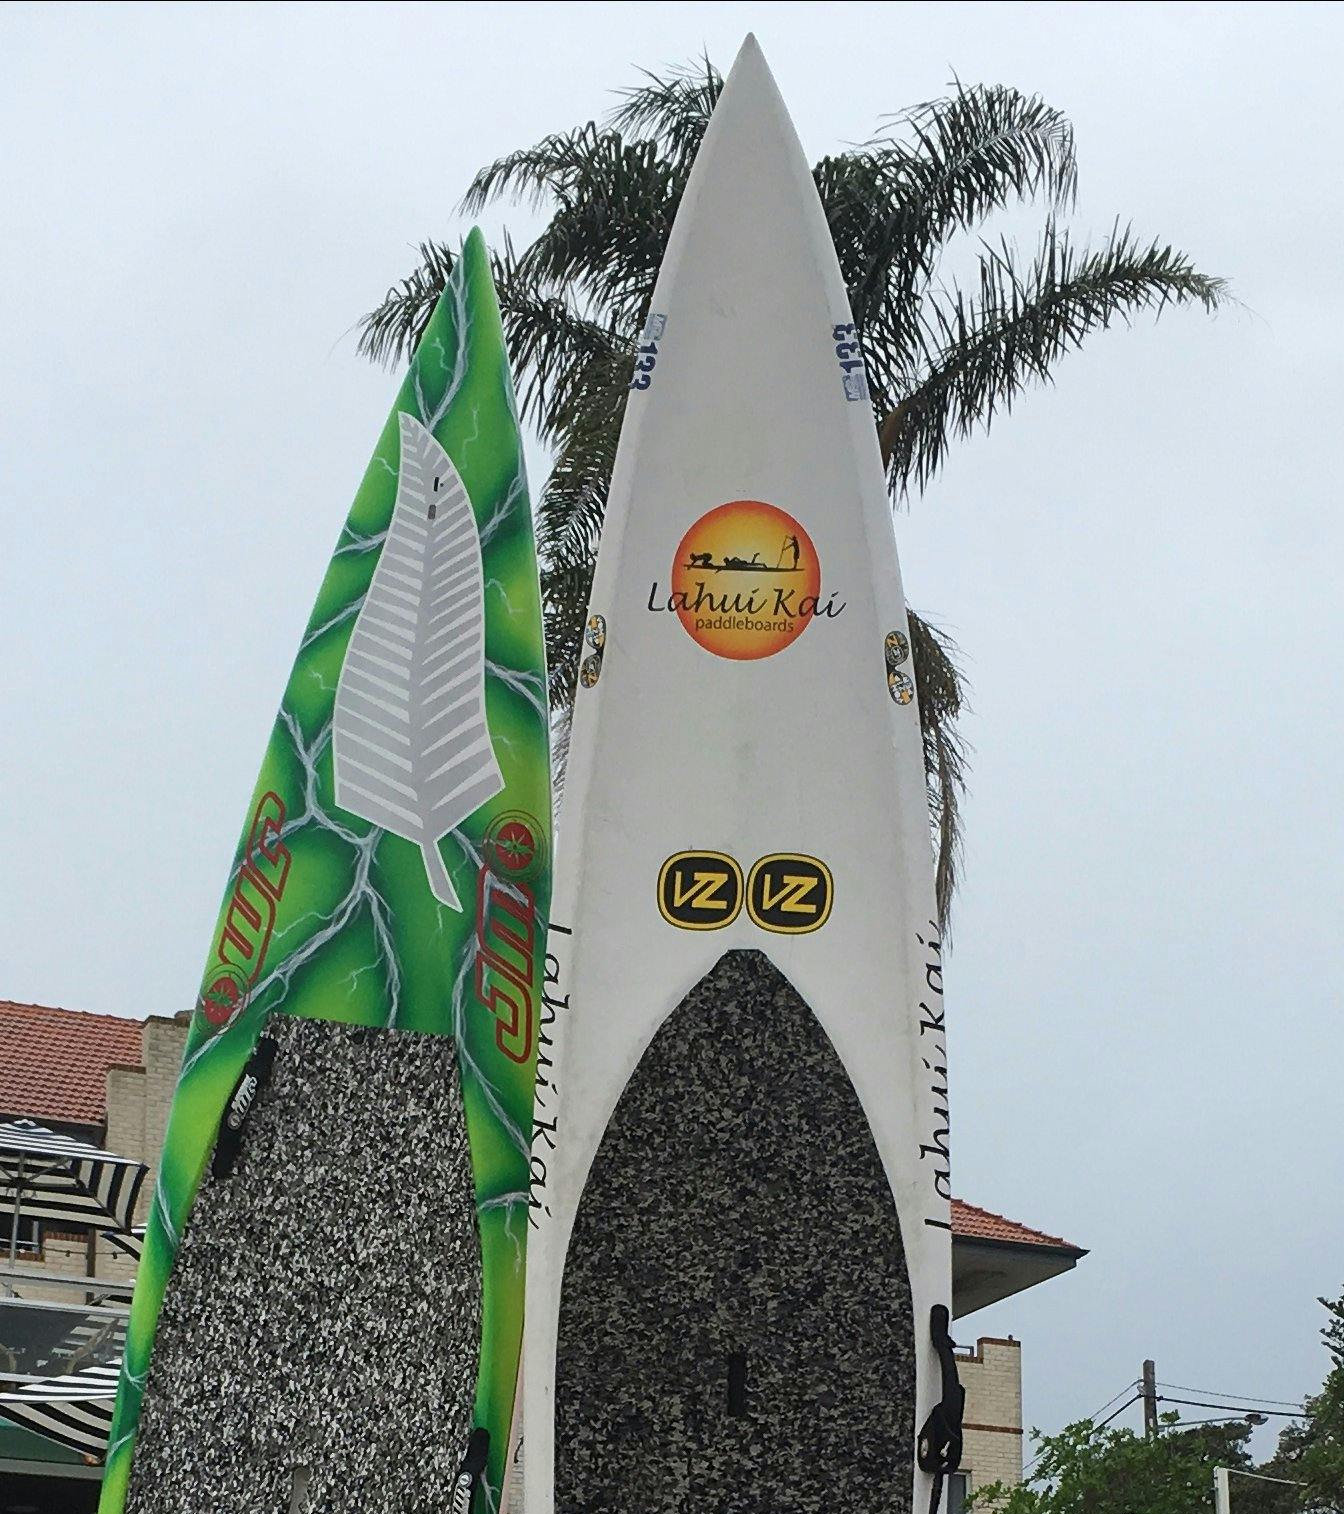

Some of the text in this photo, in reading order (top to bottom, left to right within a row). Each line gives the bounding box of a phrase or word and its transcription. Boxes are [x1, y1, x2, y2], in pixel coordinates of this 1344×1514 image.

[648, 582, 847, 618] Lahui Kai
[694, 616, 794, 633] paddleboards
